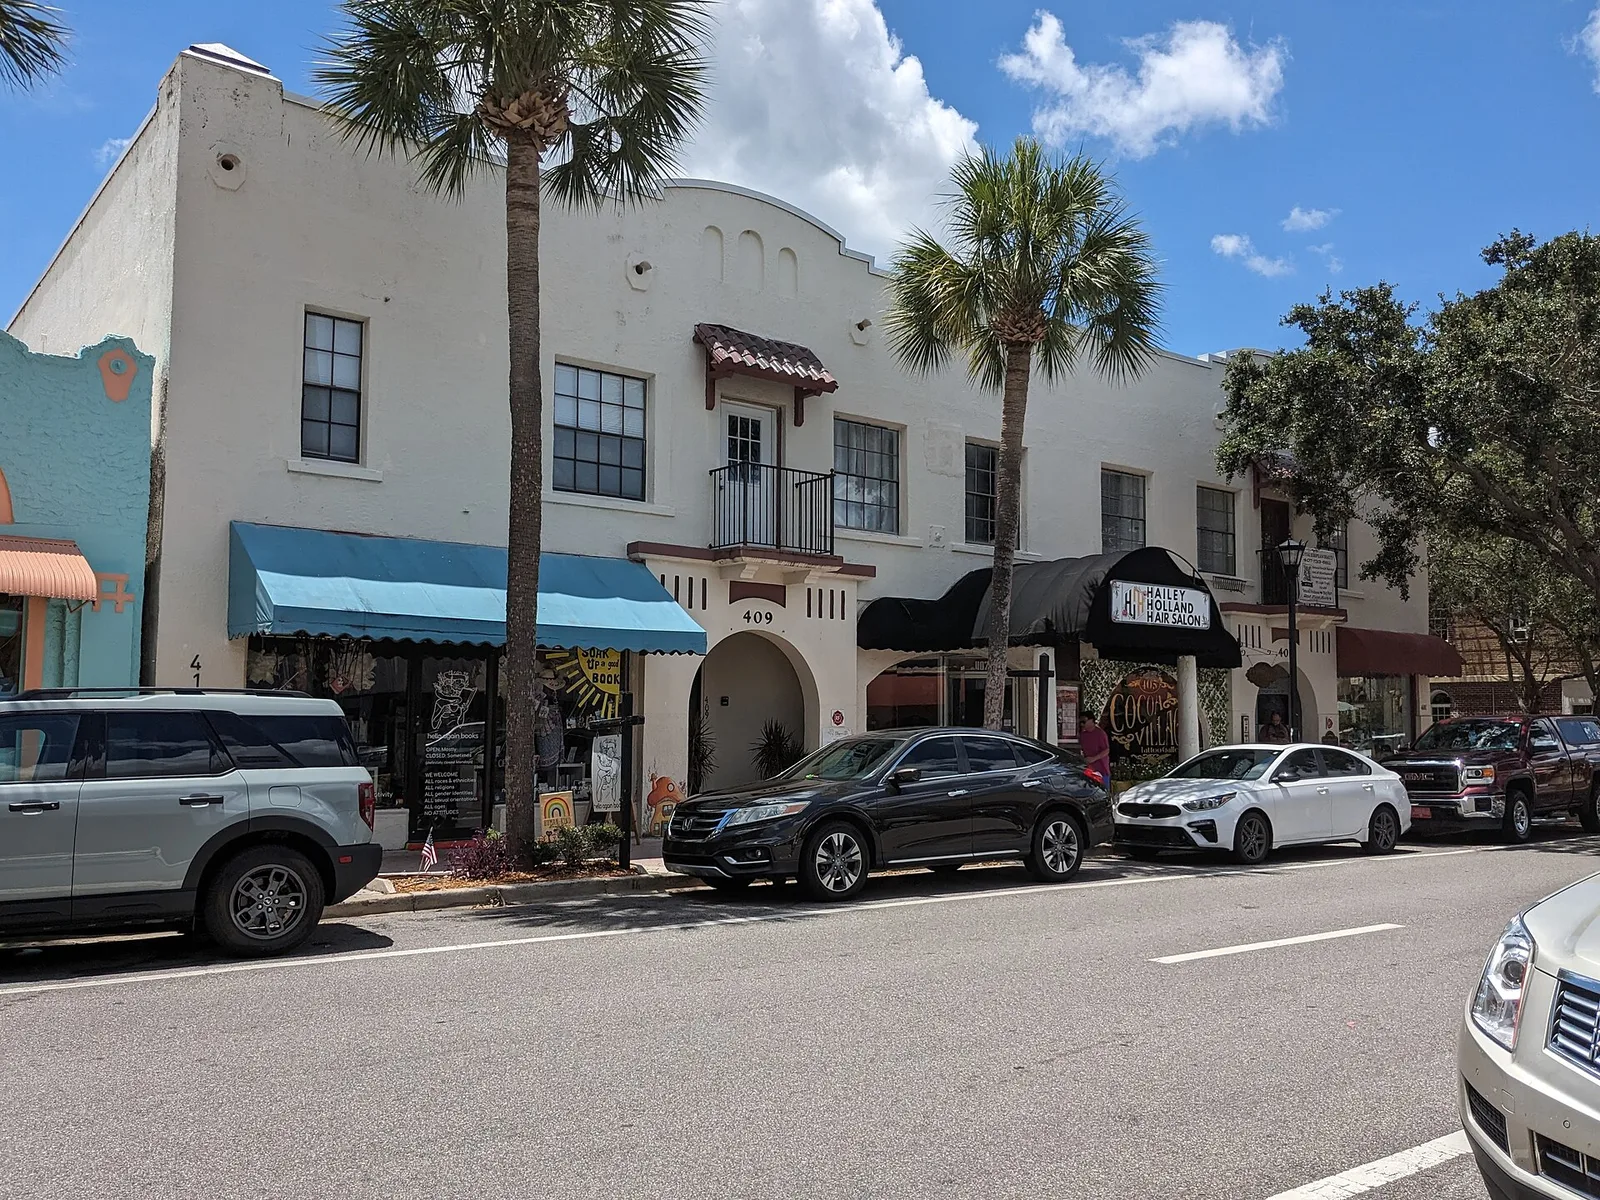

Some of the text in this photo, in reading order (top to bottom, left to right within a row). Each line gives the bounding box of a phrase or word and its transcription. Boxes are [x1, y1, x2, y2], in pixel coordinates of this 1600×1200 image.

[1147, 586, 1186, 601] HAILEY
[1147, 599, 1194, 614] HOLLAND
[743, 610, 773, 624] 409
[1147, 611, 1201, 627] HAIR SALON
[1278, 648, 1289, 657] 40
[607, 659, 619, 670] good
[592, 673, 620, 685] BOOK
[1109, 693, 1163, 732] COCOA
[1135, 708, 1179, 746] VILLAG
[1404, 772, 1435, 781] GMC
